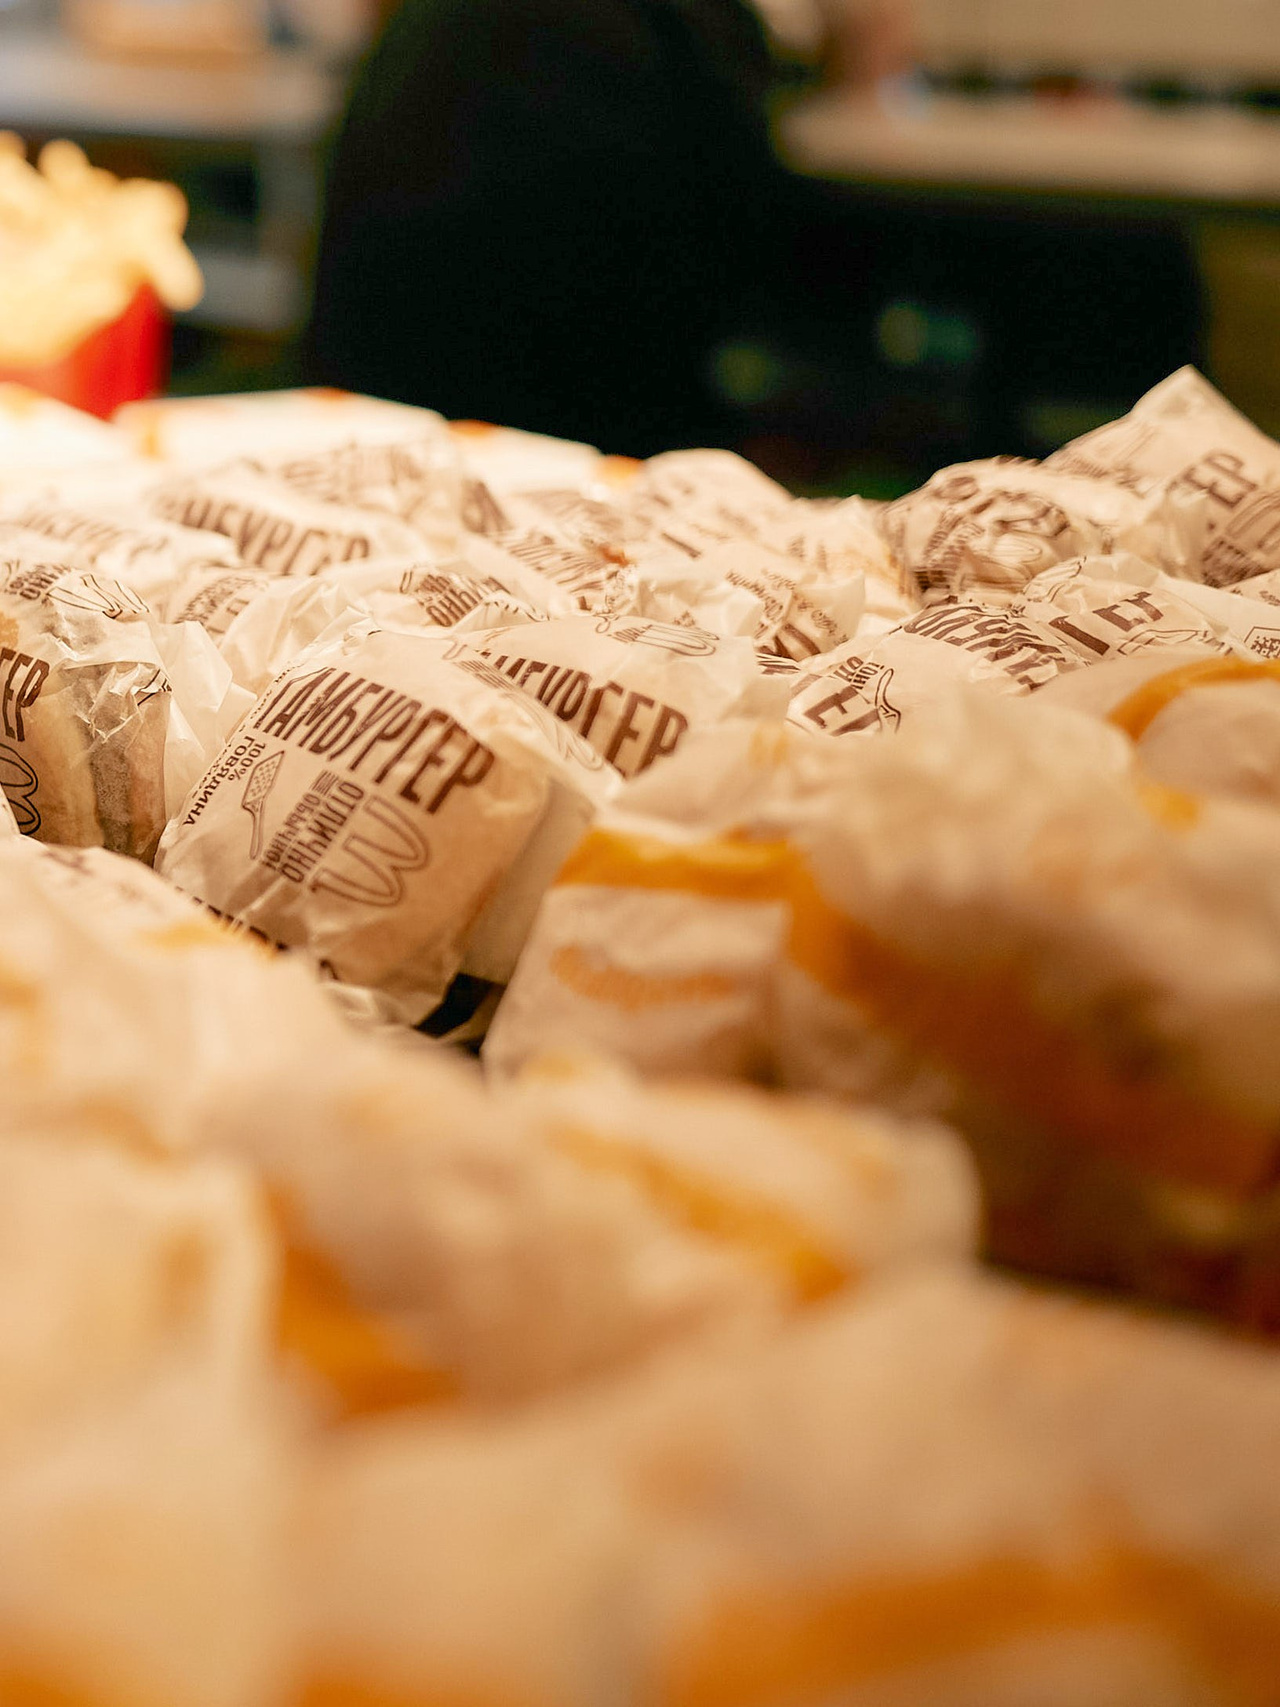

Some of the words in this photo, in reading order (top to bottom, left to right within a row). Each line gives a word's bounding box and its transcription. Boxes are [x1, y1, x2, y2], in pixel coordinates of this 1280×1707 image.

[183, 735, 256, 828] ГОВЯДИНА
[228, 741, 267, 781] 100%
[256, 667, 495, 815] ГАМБУРГЕР
[280, 780, 366, 884] ОТЛИЧНО
